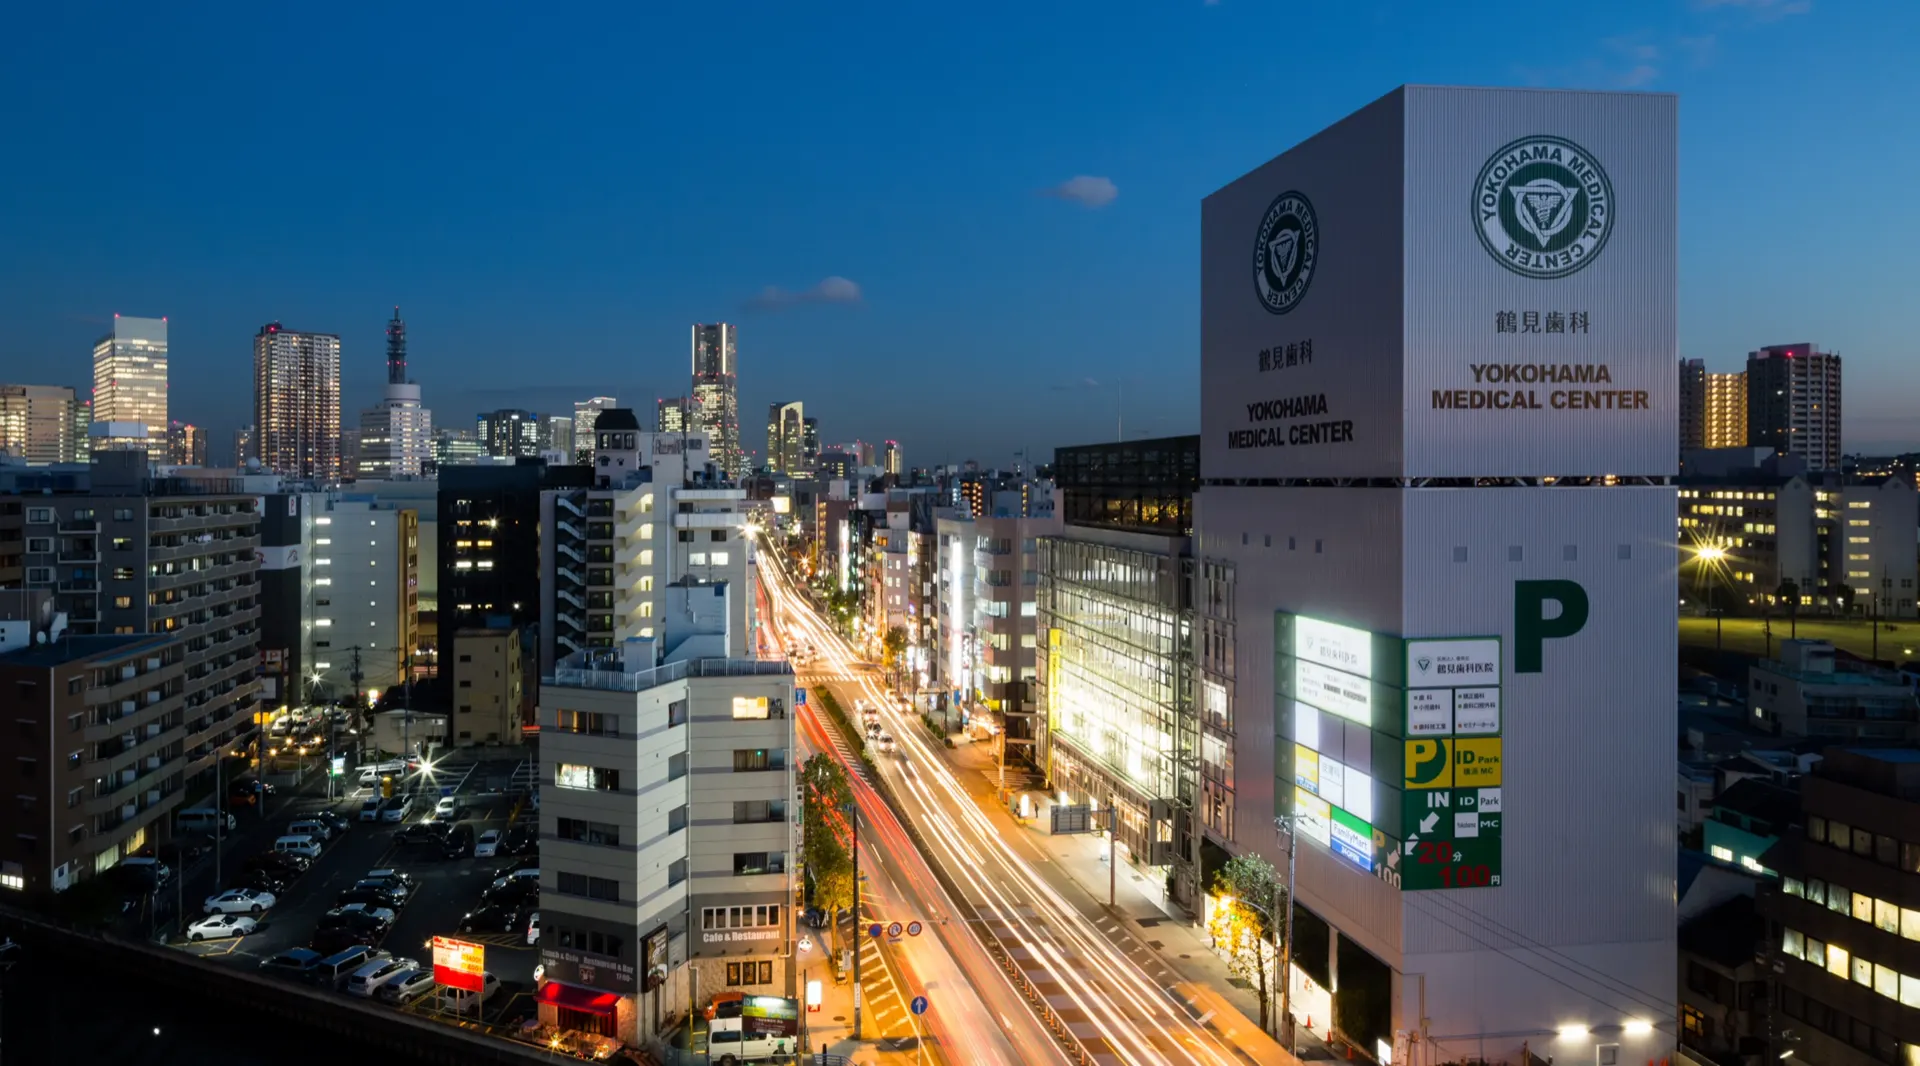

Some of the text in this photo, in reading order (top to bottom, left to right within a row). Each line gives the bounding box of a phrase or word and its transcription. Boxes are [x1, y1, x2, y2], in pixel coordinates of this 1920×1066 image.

[1482, 145, 1605, 269] YOKOHAMA MEDICAL CENTER
[1256, 199, 1314, 306] YOKOHAMA MEDICAL CENTER
[1496, 310, 1590, 334] 鶴見歯科
[1258, 338, 1313, 373] 鶴見歯科
[1469, 363, 1612, 384] YOKOHAMA
[1246, 392, 1328, 422] YOKOHAMA
[1431, 390, 1650, 410] MEDICAL CENTER
[1228, 419, 1354, 450] MEDICAL CENTER
[1515, 580, 1588, 673] P
[1437, 662, 1494, 674] 鶴見歯科医院
[1405, 740, 1438, 778] P
[1456, 750, 1500, 764] ID Park
[1480, 767, 1494, 775] MC
[1427, 791, 1450, 808] IN
[1460, 796, 1500, 806] ID Park
[1480, 819, 1500, 828] MC
[1334, 822, 1368, 851] FamilyMart
[702, 930, 780, 944] Cafe & Restaurant
[910, 924, 919, 933] 40
[622, 963, 634, 974] Bar
